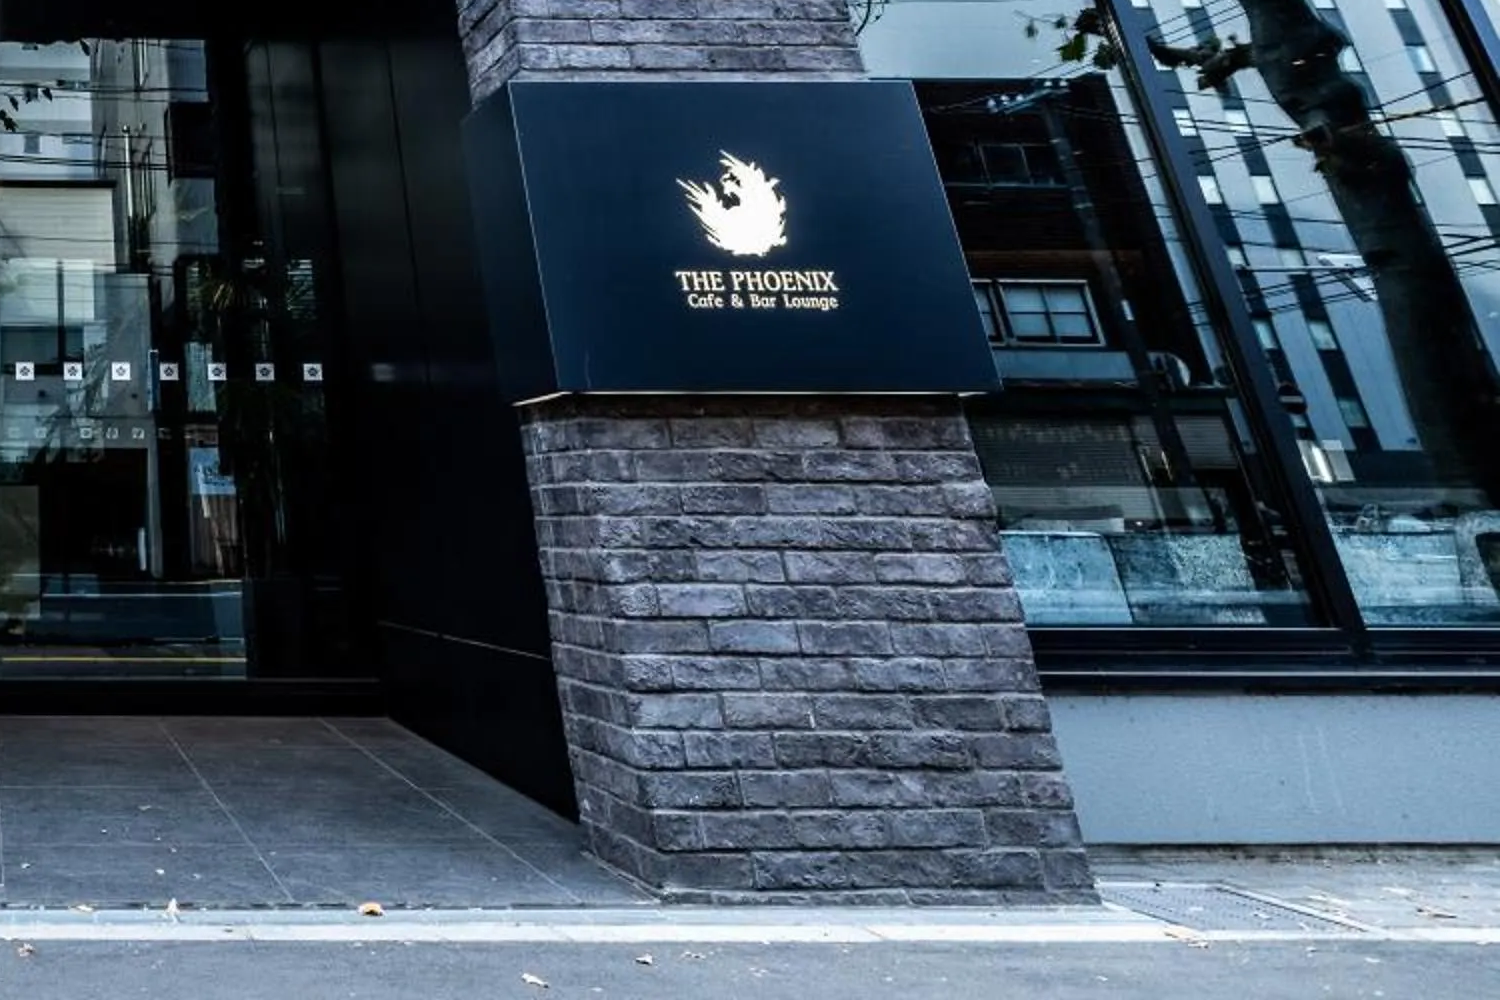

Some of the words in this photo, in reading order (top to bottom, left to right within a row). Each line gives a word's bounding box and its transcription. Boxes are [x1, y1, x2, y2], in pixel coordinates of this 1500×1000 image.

[674, 270, 725, 291] THE
[729, 270, 839, 292] PHOENIX
[687, 293, 724, 309] Cafe
[731, 293, 744, 309] &
[750, 294, 776, 309] Bar
[783, 294, 839, 312] Lounge
